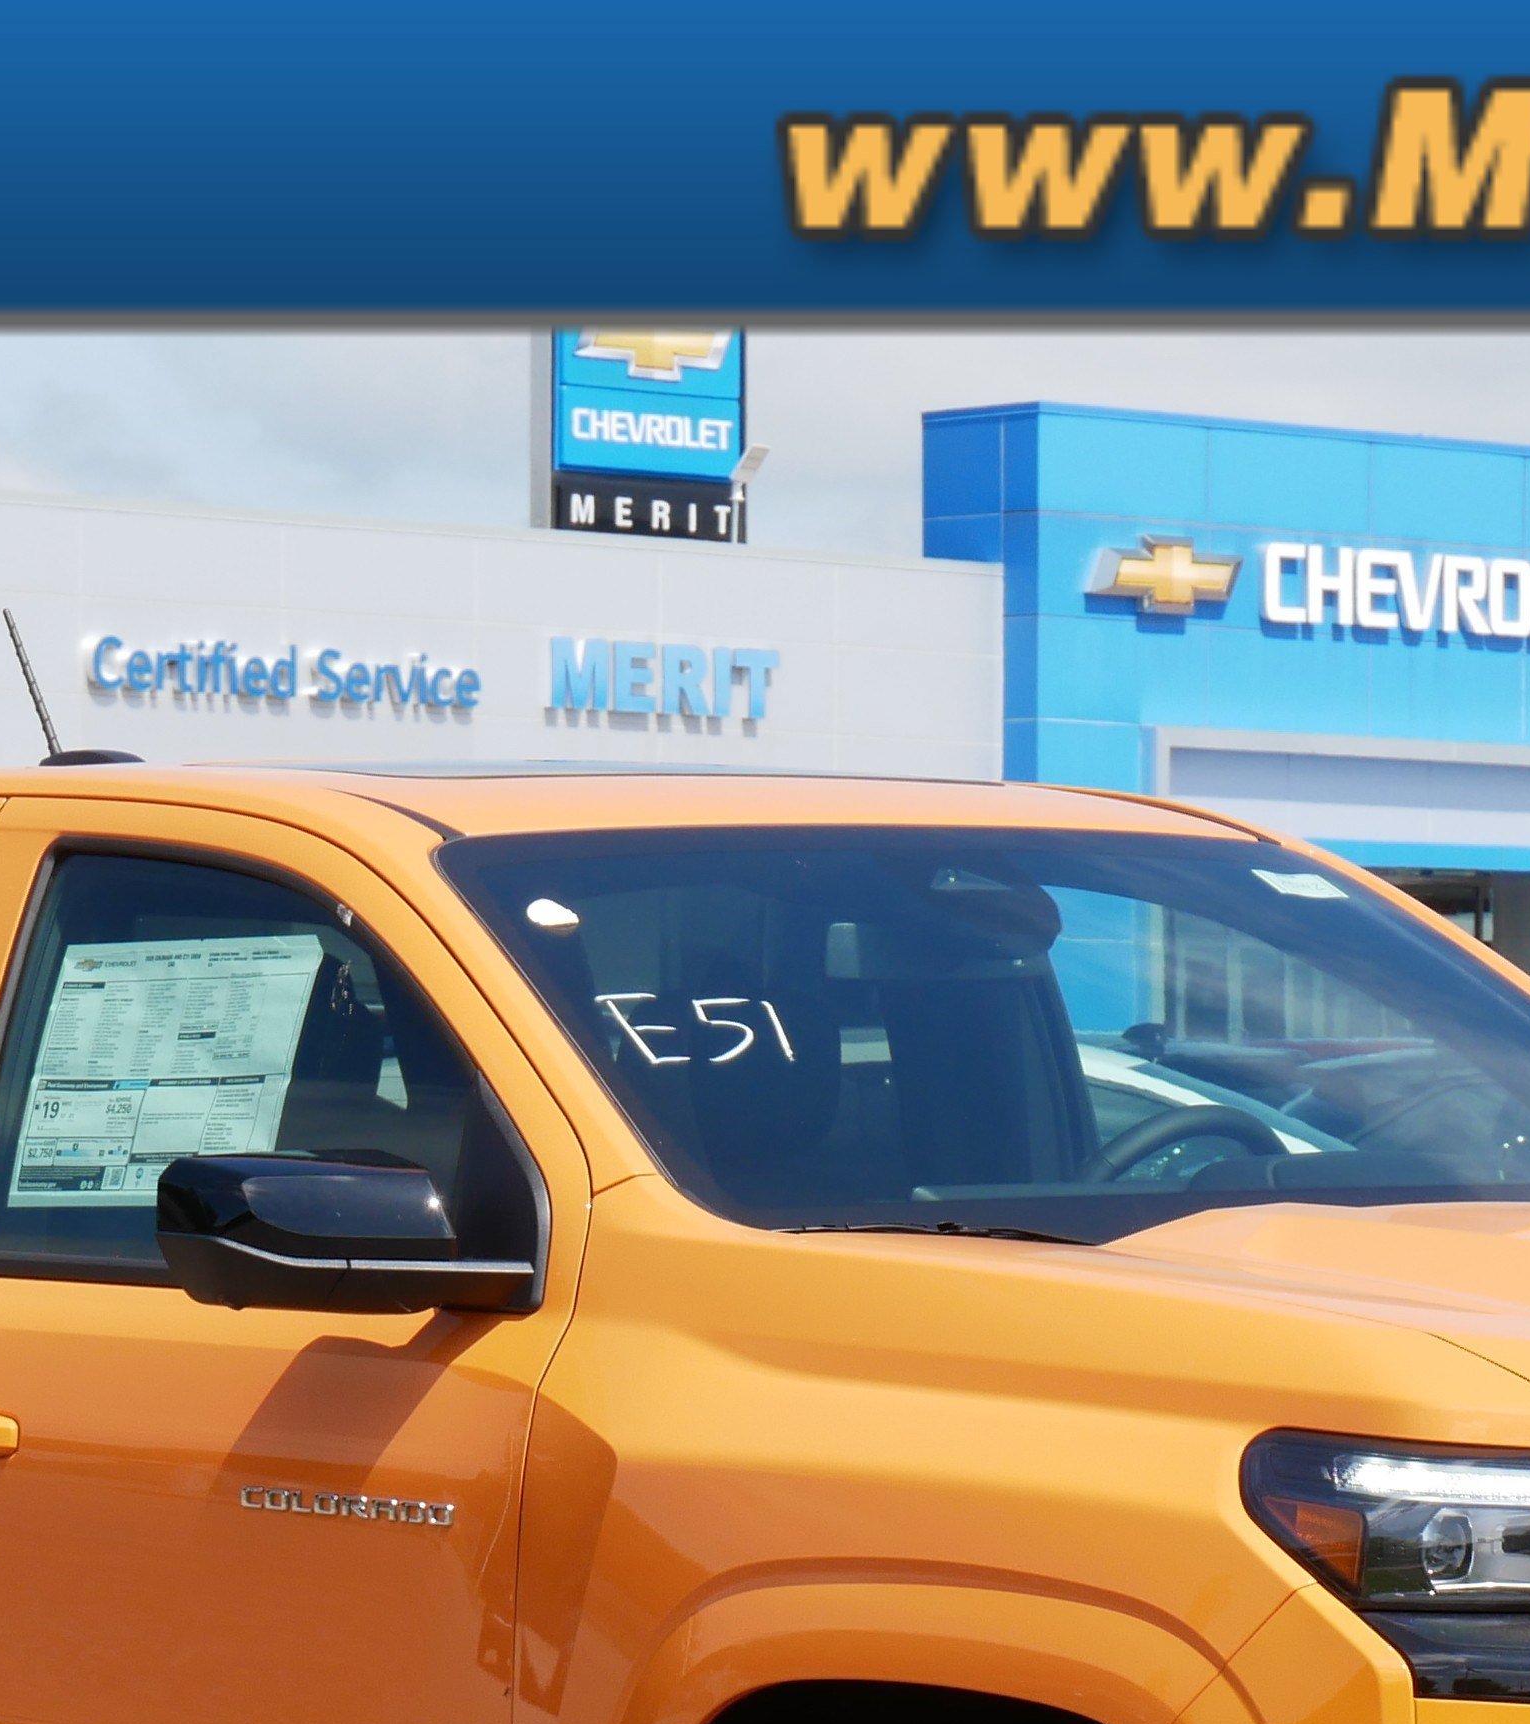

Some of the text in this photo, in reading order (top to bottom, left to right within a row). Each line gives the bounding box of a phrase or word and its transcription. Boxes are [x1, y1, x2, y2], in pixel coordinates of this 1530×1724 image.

[571, 407, 733, 451] CHEVROLET
[570, 493, 731, 535] MERIT
[92, 636, 482, 708] Certified Service
[550, 636, 781, 720] MERIT
[594, 992, 798, 1066] E51
[42, 1101, 60, 1119] 19
[240, 1486, 454, 1526] COLORADO
